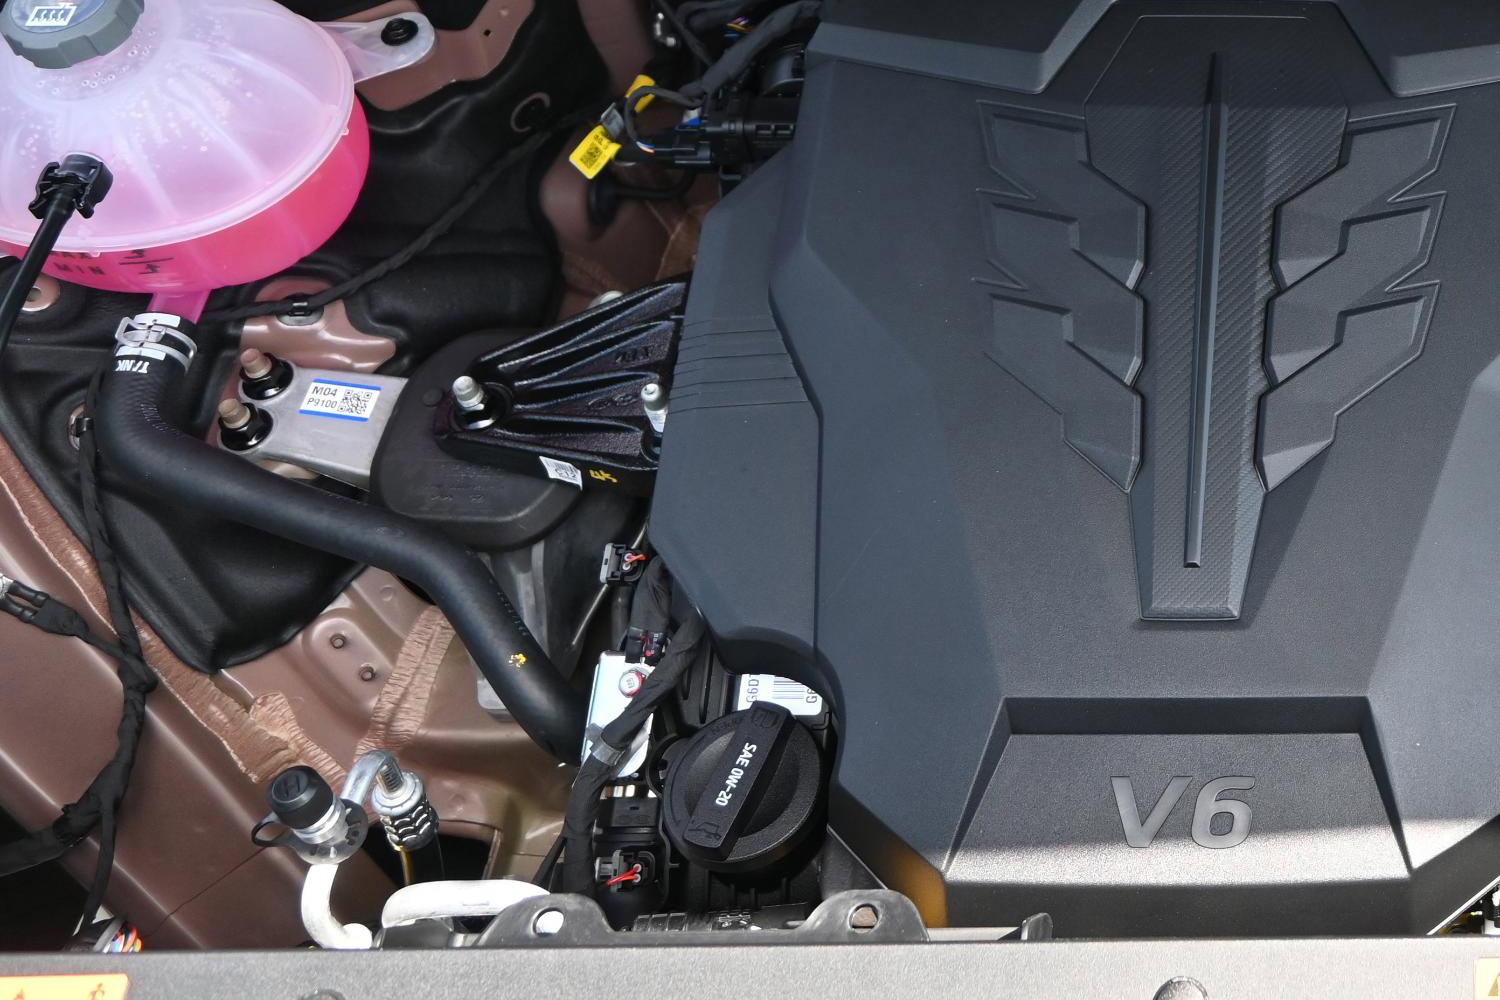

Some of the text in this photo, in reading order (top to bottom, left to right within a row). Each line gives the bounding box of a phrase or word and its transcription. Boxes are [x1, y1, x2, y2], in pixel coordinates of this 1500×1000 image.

[306, 397, 338, 409] P9100
[312, 386, 338, 397] M04
[746, 674, 759, 703] G6D
[715, 742, 757, 807] SAE 0W-20
[1110, 775, 1256, 850] V6
